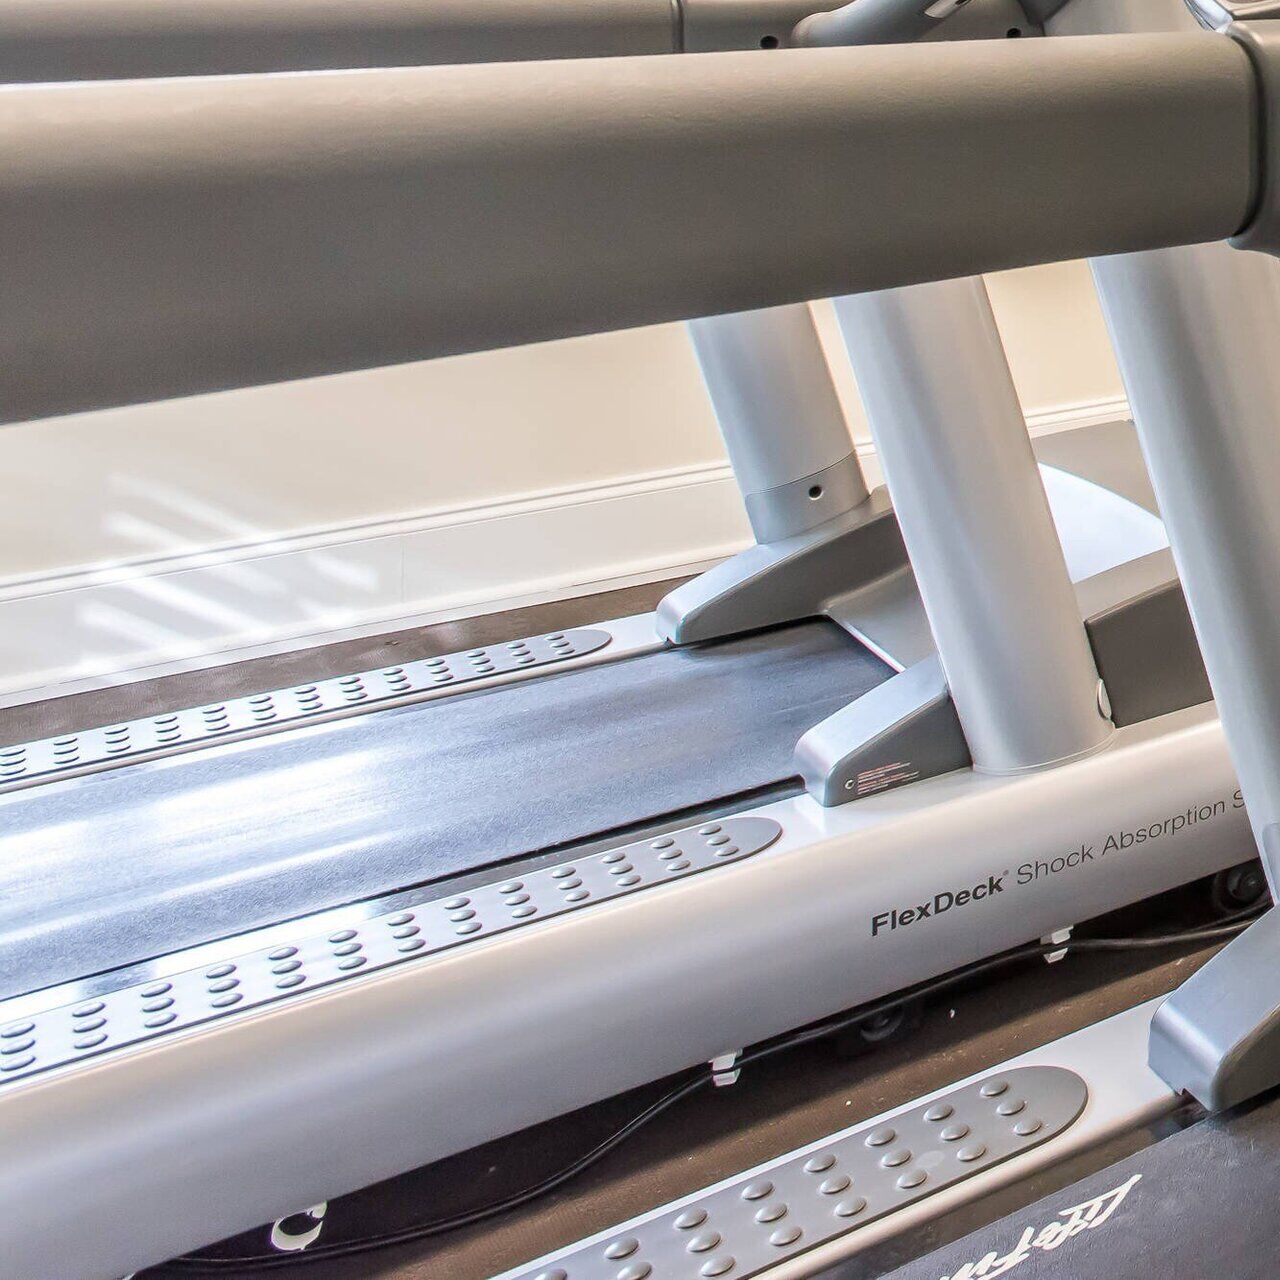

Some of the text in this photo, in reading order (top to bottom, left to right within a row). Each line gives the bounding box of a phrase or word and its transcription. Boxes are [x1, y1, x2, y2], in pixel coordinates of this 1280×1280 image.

[871, 799, 1226, 937] FlexDeck Shock Absorption
